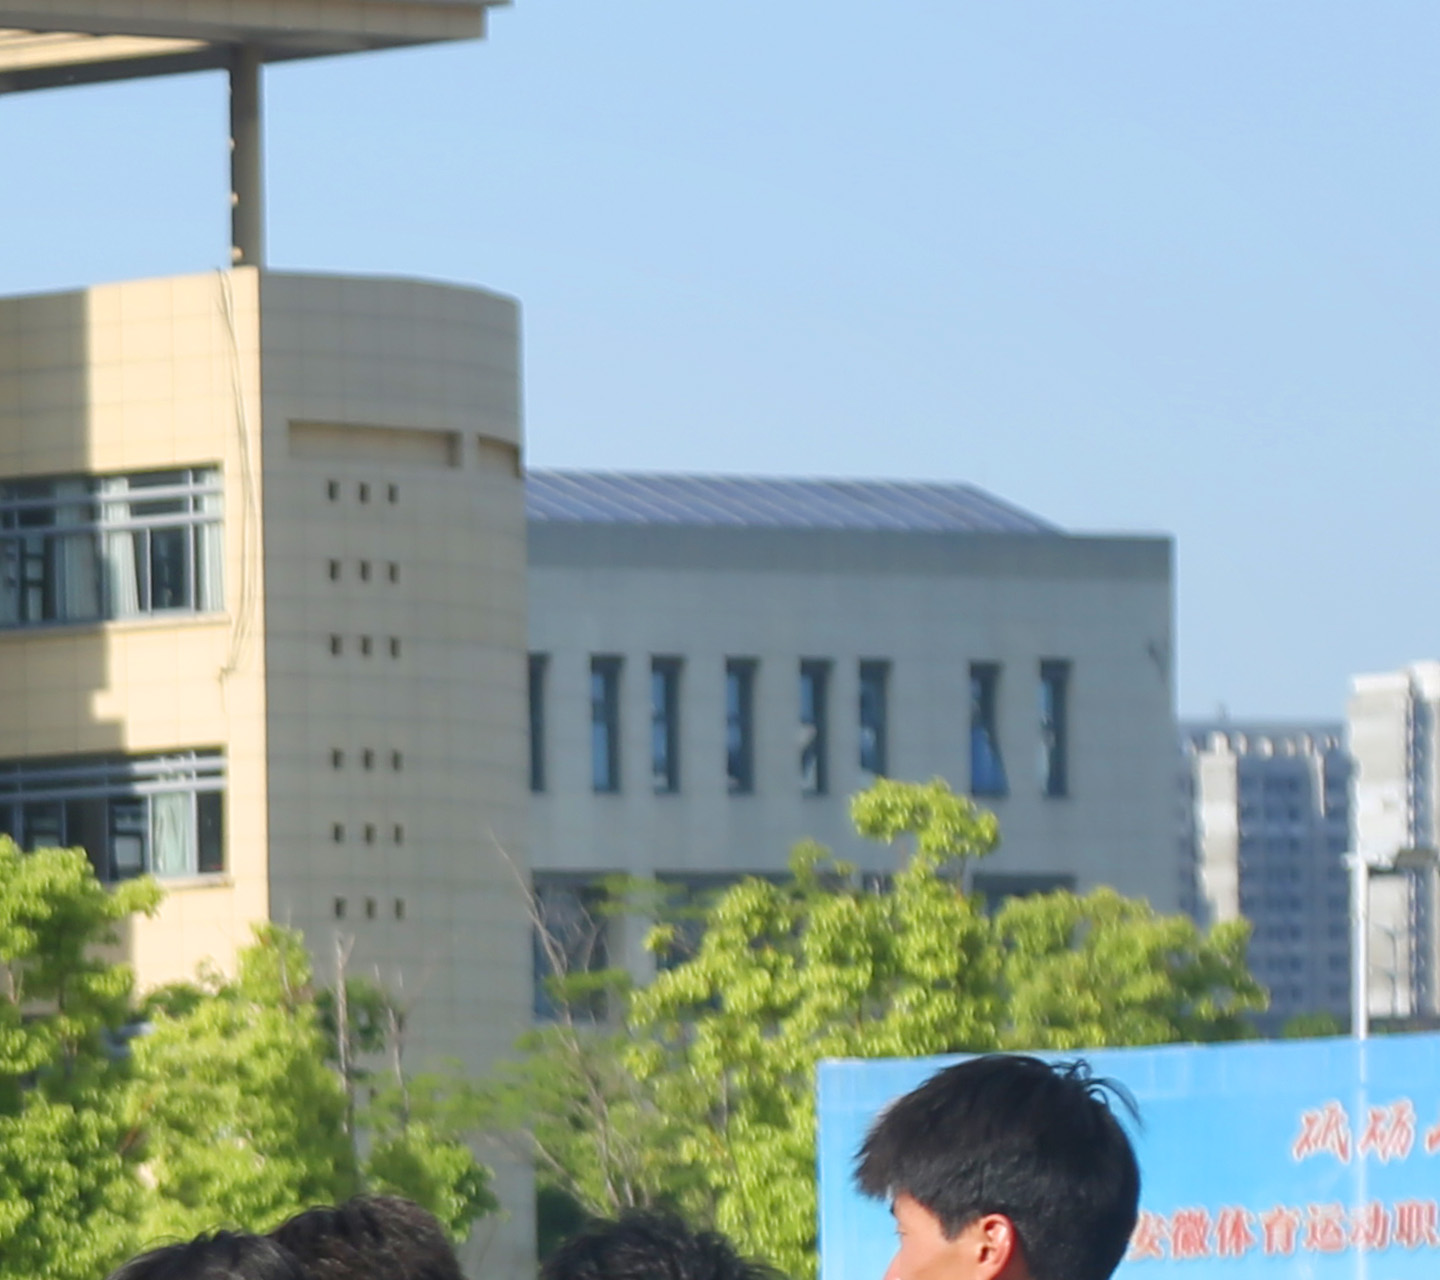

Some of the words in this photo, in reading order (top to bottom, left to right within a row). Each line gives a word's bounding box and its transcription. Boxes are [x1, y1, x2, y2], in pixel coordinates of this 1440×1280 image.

[1292, 1099, 1440, 1162] 砥砺
[1130, 1202, 1437, 1257] 安徽体育运动职
